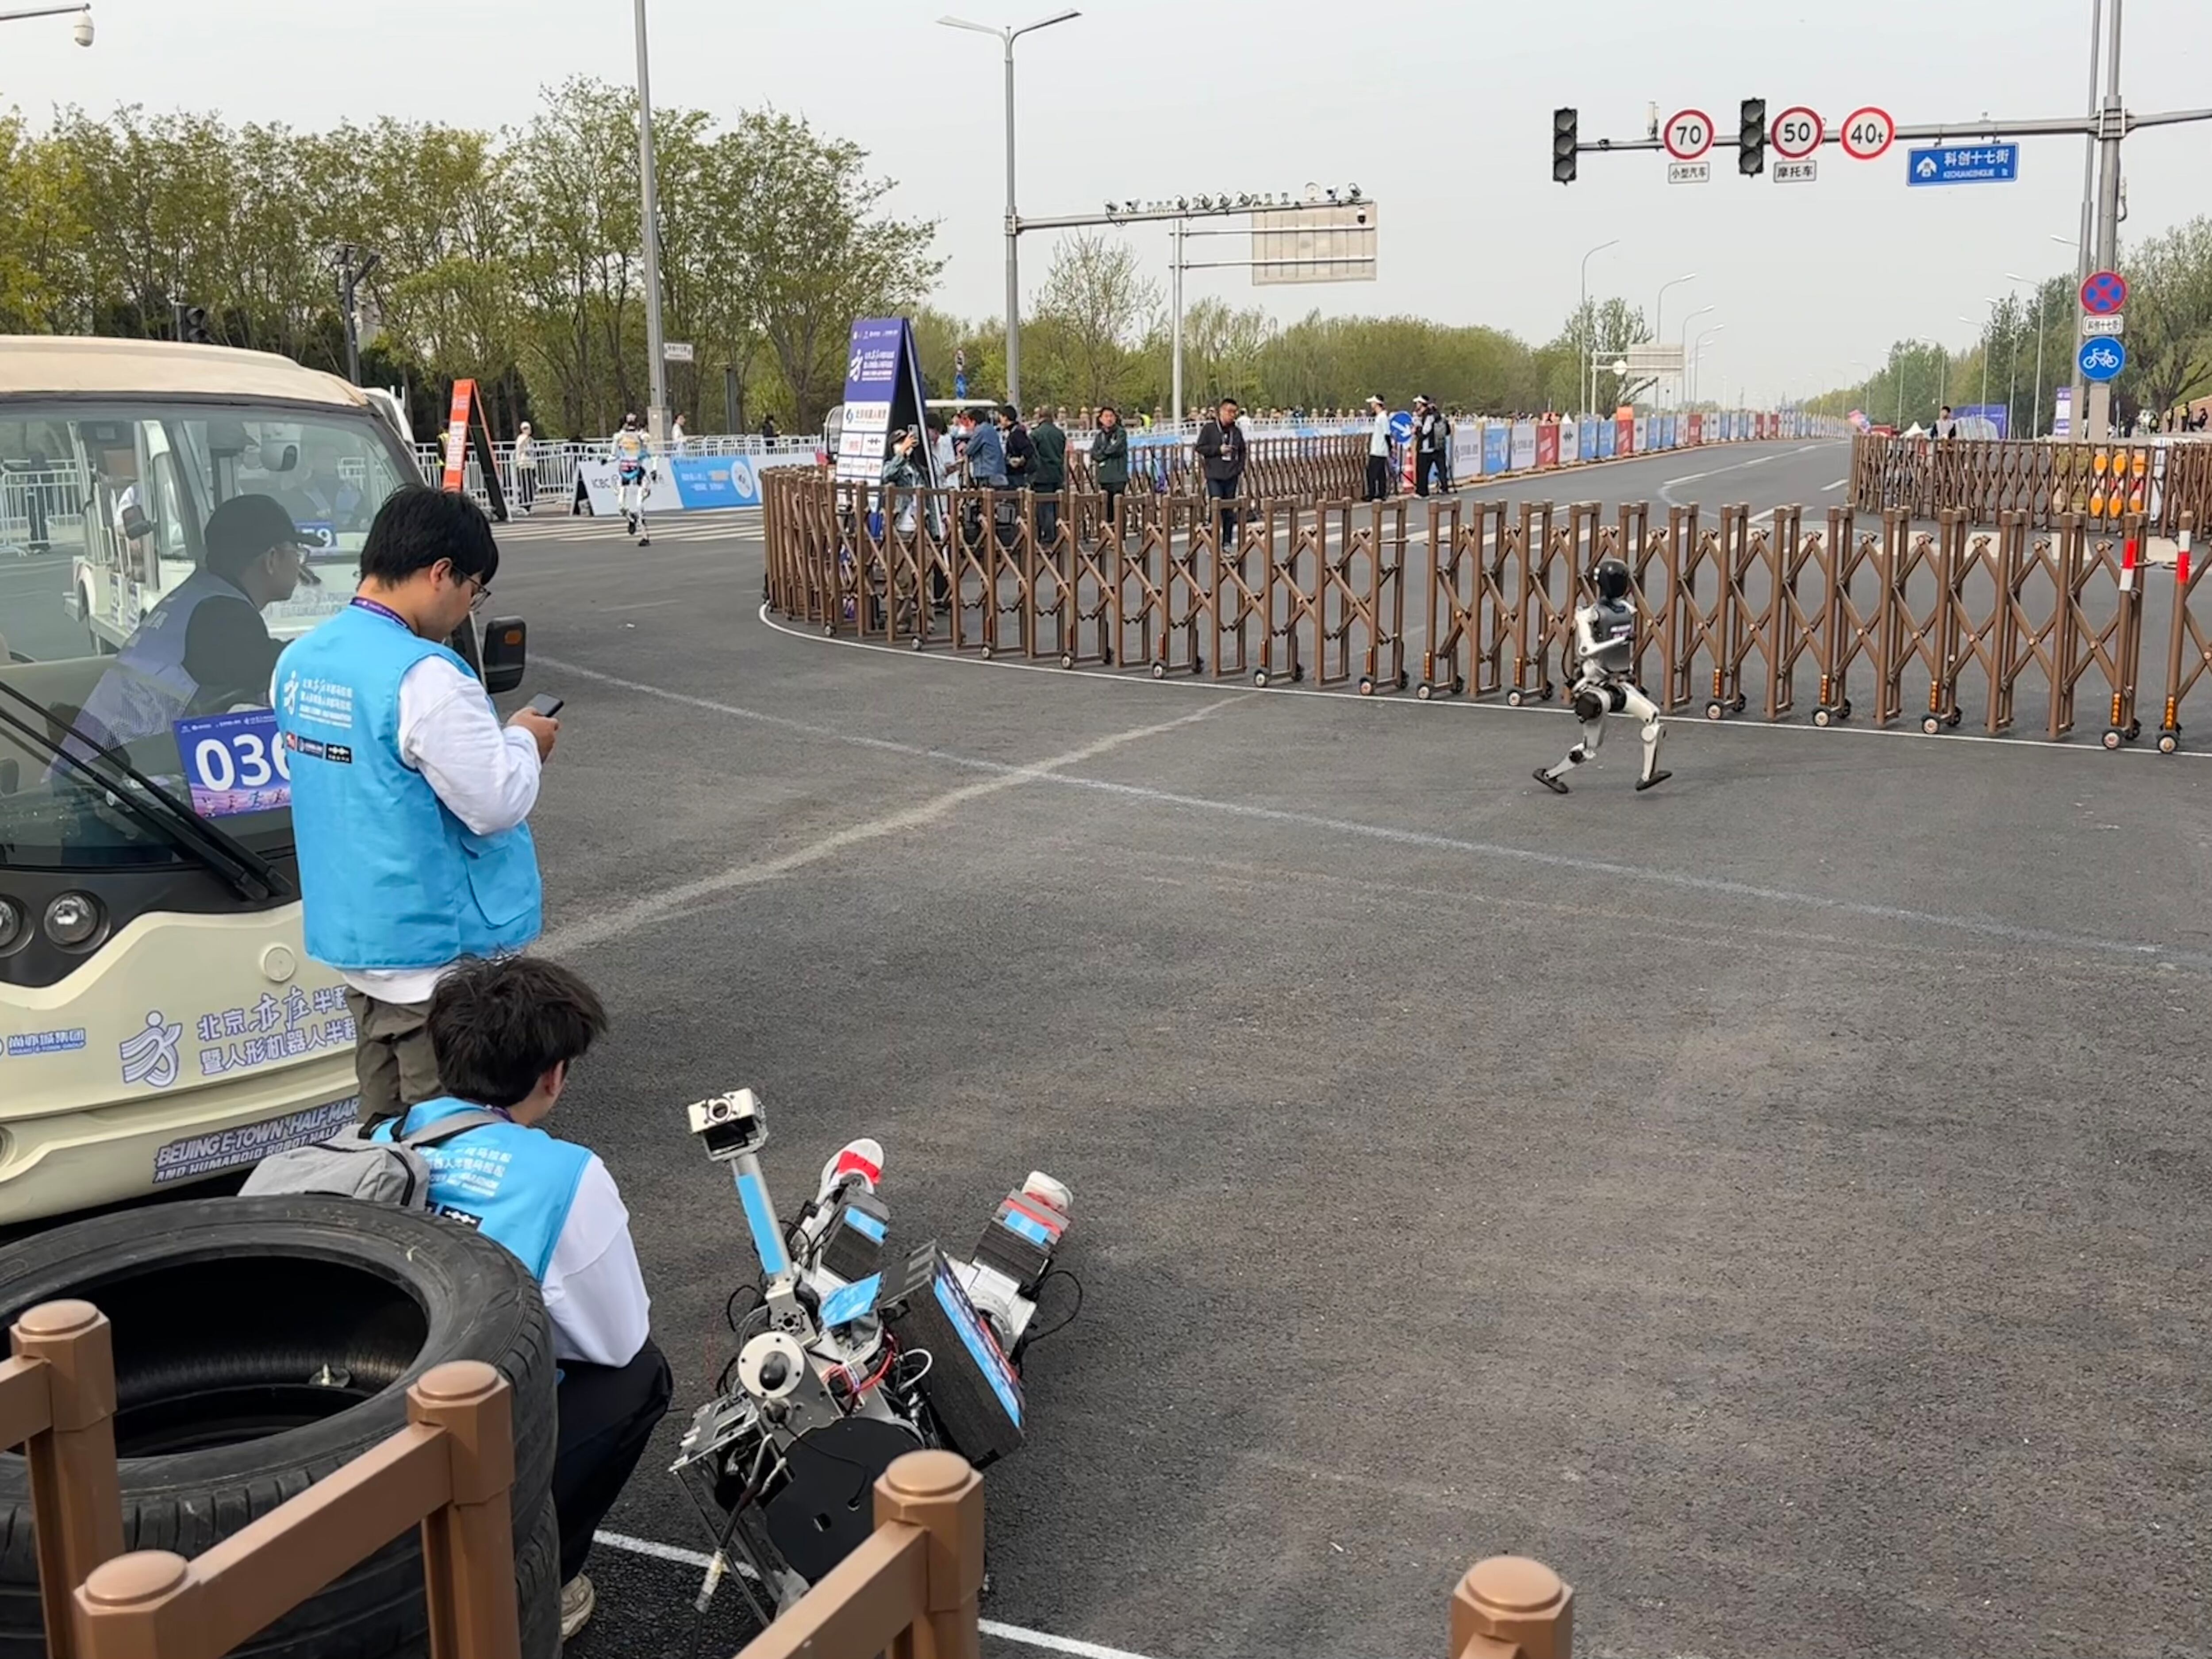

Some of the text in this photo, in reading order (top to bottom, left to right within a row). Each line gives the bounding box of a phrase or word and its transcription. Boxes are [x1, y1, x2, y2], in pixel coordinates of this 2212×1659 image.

[1676, 125, 1701, 146] 70
[1784, 122, 1810, 142] 50
[1851, 123, 1884, 145] 40t
[1944, 149, 2009, 167] 科创十七街
[1671, 166, 1707, 179] 小型汽车
[1776, 165, 1813, 178] 摩托车
[157, 1135, 221, 1167] BEIJING
[221, 1119, 284, 1152] E-TOWN
[289, 1106, 327, 1135] HALF
[155, 1127, 338, 1182] AND HUMANOID ROBOT HALF
